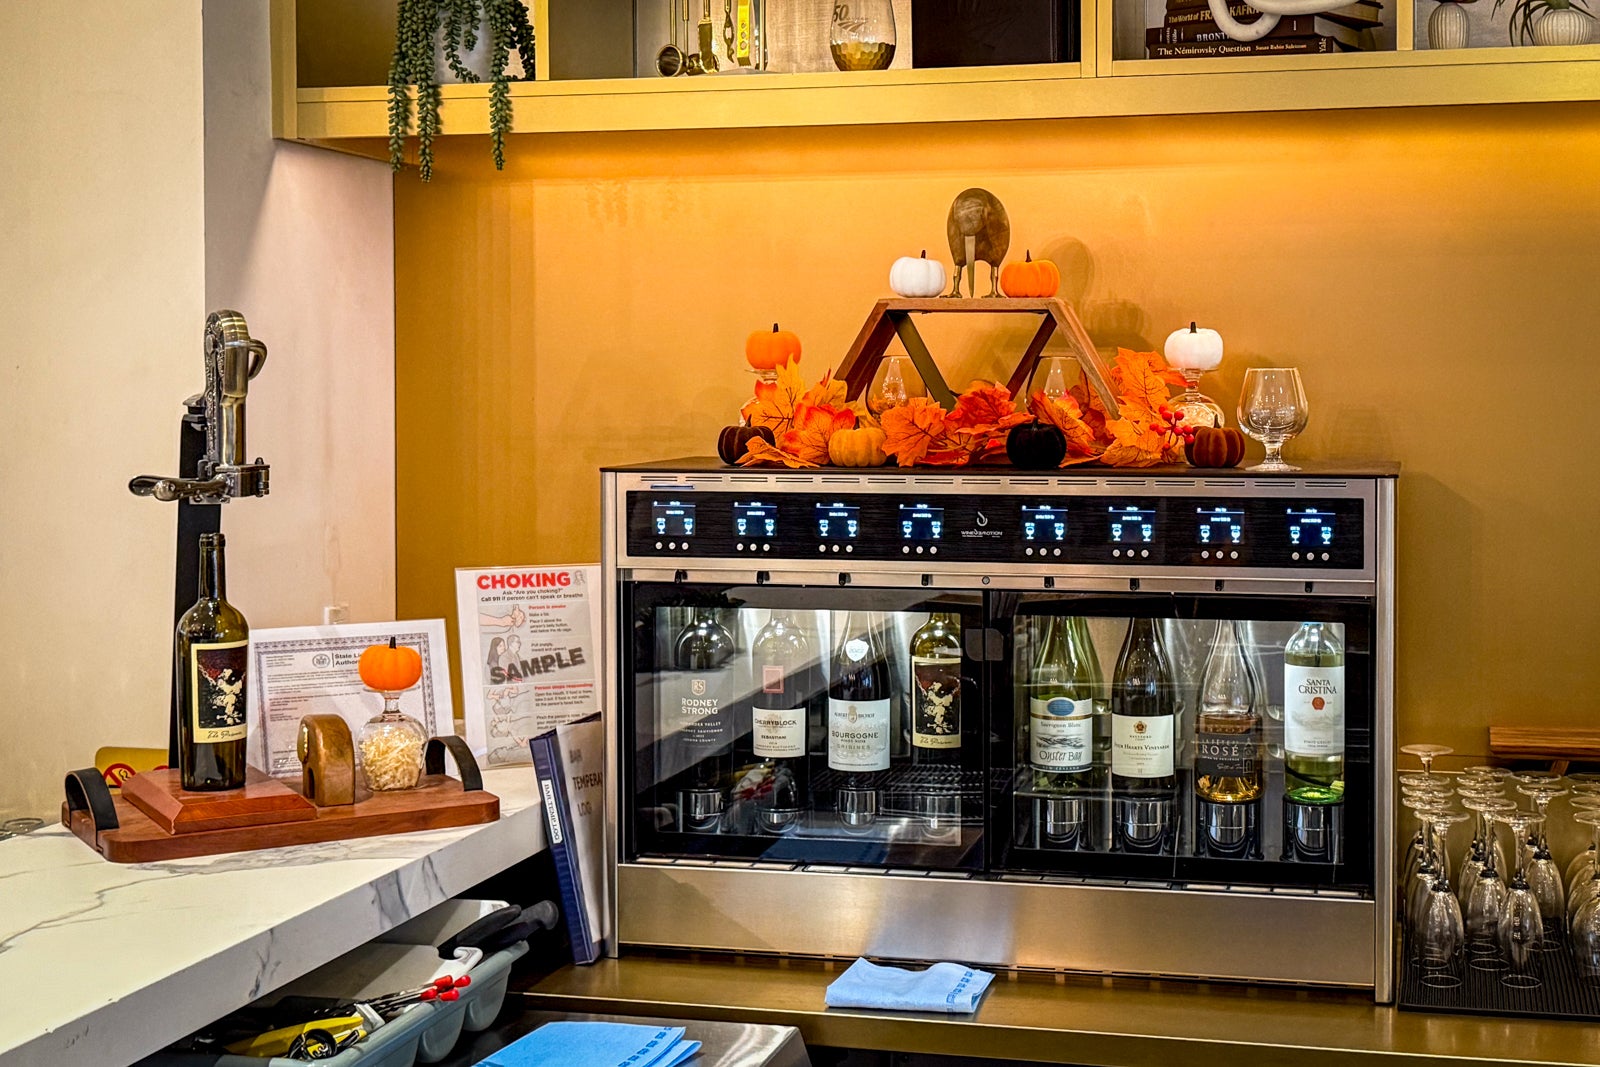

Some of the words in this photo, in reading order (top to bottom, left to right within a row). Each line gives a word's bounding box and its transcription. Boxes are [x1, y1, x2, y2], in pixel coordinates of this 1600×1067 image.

[1157, 47, 1172, 55] The
[1218, 44, 1251, 53] Question
[1318, 38, 1327, 52] Yale
[476, 571, 571, 590] CHOKING
[490, 647, 586, 684] SAMPLE
[1298, 685, 1337, 695] CRISTINA
[681, 697, 719, 707] RODNEY
[681, 706, 719, 715] STRONG
[831, 730, 879, 740] BOURGOGNE
[1202, 744, 1239, 757] ROSÉ
